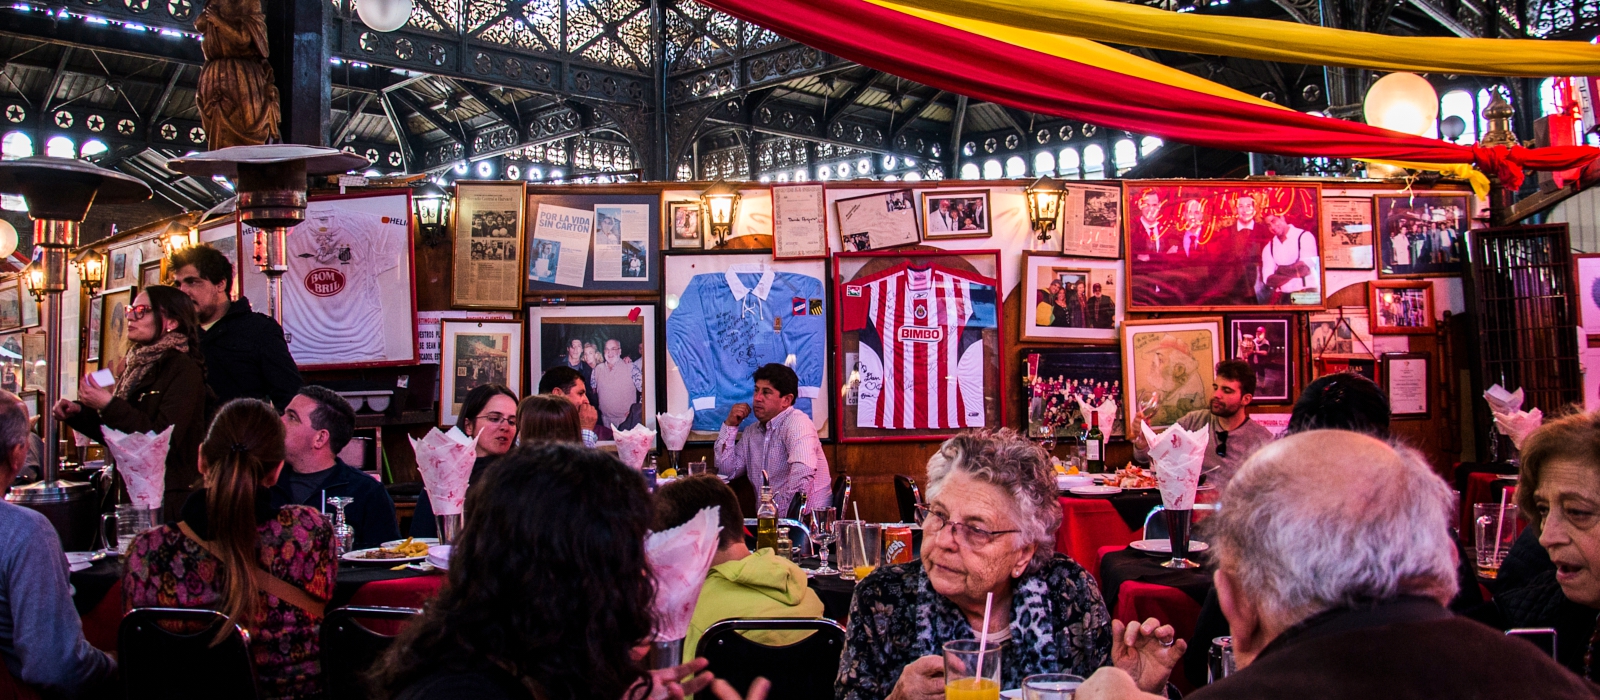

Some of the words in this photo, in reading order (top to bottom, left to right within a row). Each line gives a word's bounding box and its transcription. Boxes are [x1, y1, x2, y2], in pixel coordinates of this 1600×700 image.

[389, 217, 408, 227] HELI
[538, 218, 554, 229] SIN
[540, 211, 557, 221] POR
[559, 214, 570, 223] LA
[571, 216, 590, 226] VIDA
[310, 271, 335, 284] BOM
[314, 281, 340, 295] BRIL
[901, 328, 940, 340] BIMBO
